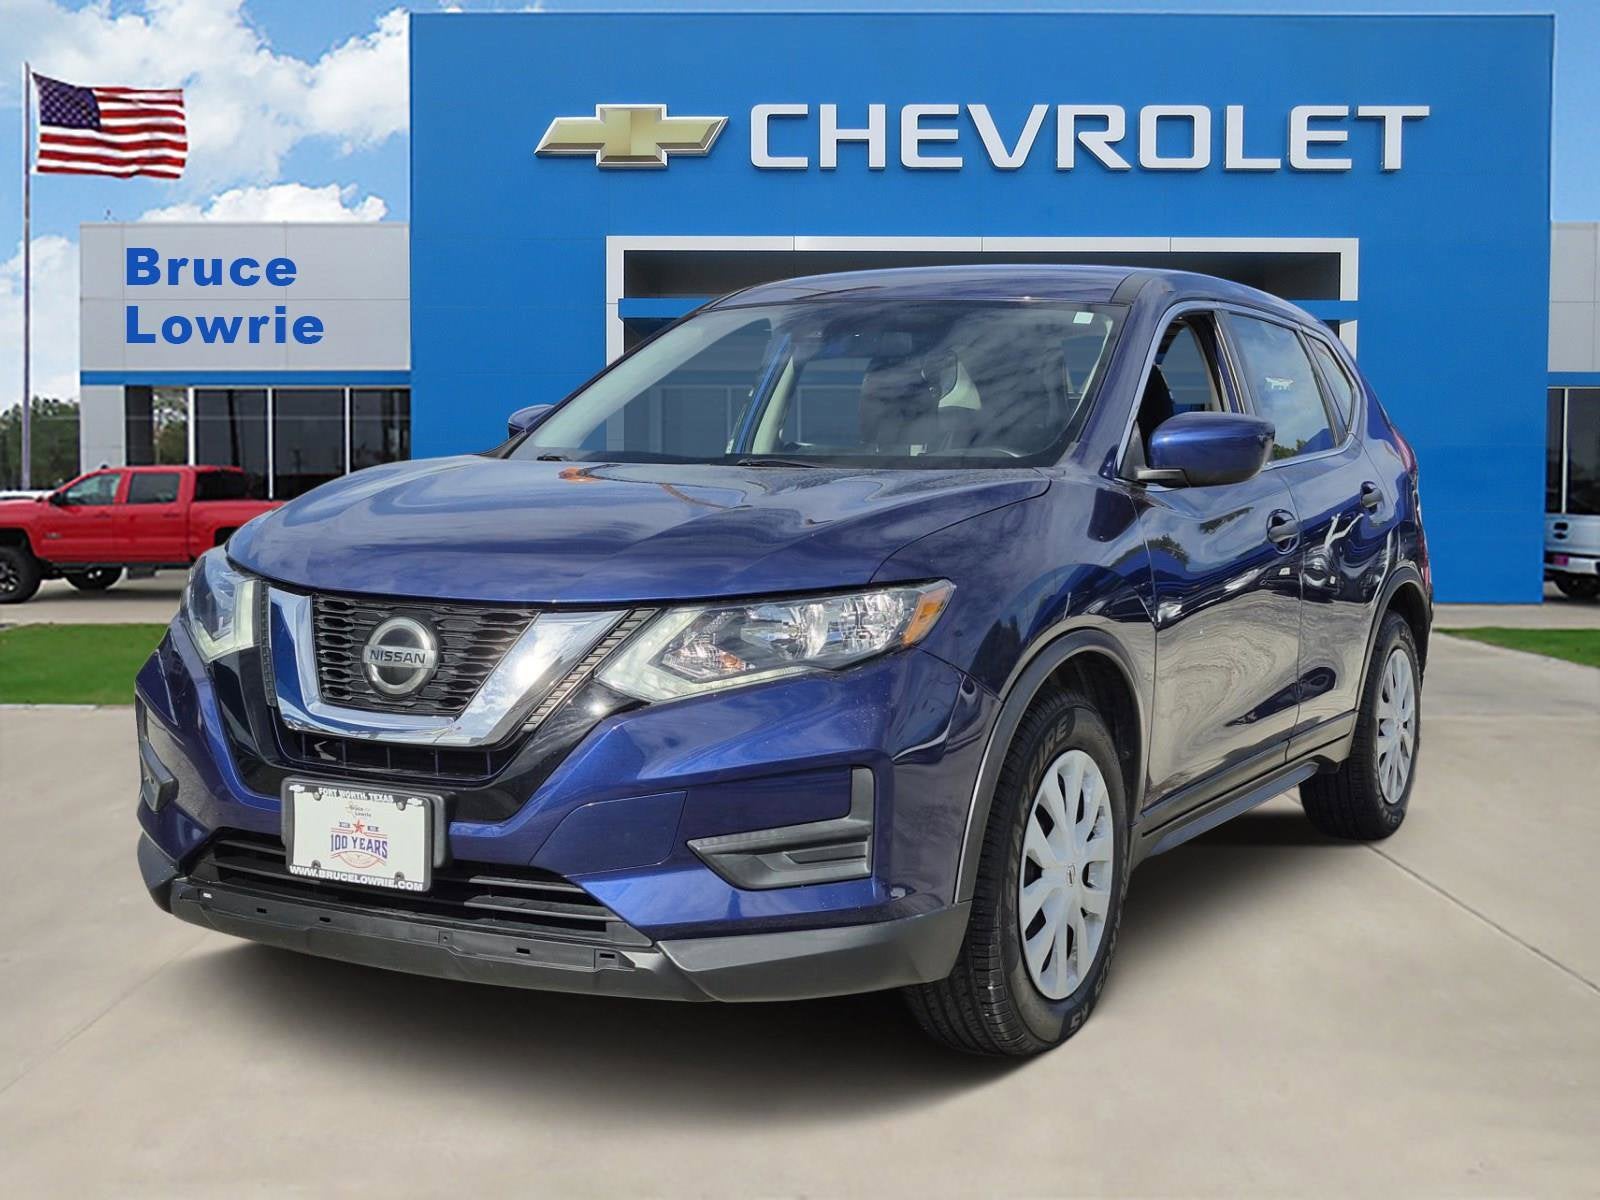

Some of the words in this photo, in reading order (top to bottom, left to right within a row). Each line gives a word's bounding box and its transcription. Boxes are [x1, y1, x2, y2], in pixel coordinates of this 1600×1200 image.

[750, 103, 1430, 171] CHEVROLET
[126, 247, 297, 287] Bruce
[126, 305, 324, 345] Lowrie
[369, 649, 426, 664] NISSAN
[318, 787, 337, 798] FORT
[368, 793, 394, 802] TEXAS
[330, 834, 348, 852] 100
[352, 835, 388, 859] YEARS
[289, 865, 423, 891] WWW.BRUCELOWRIE.COM
